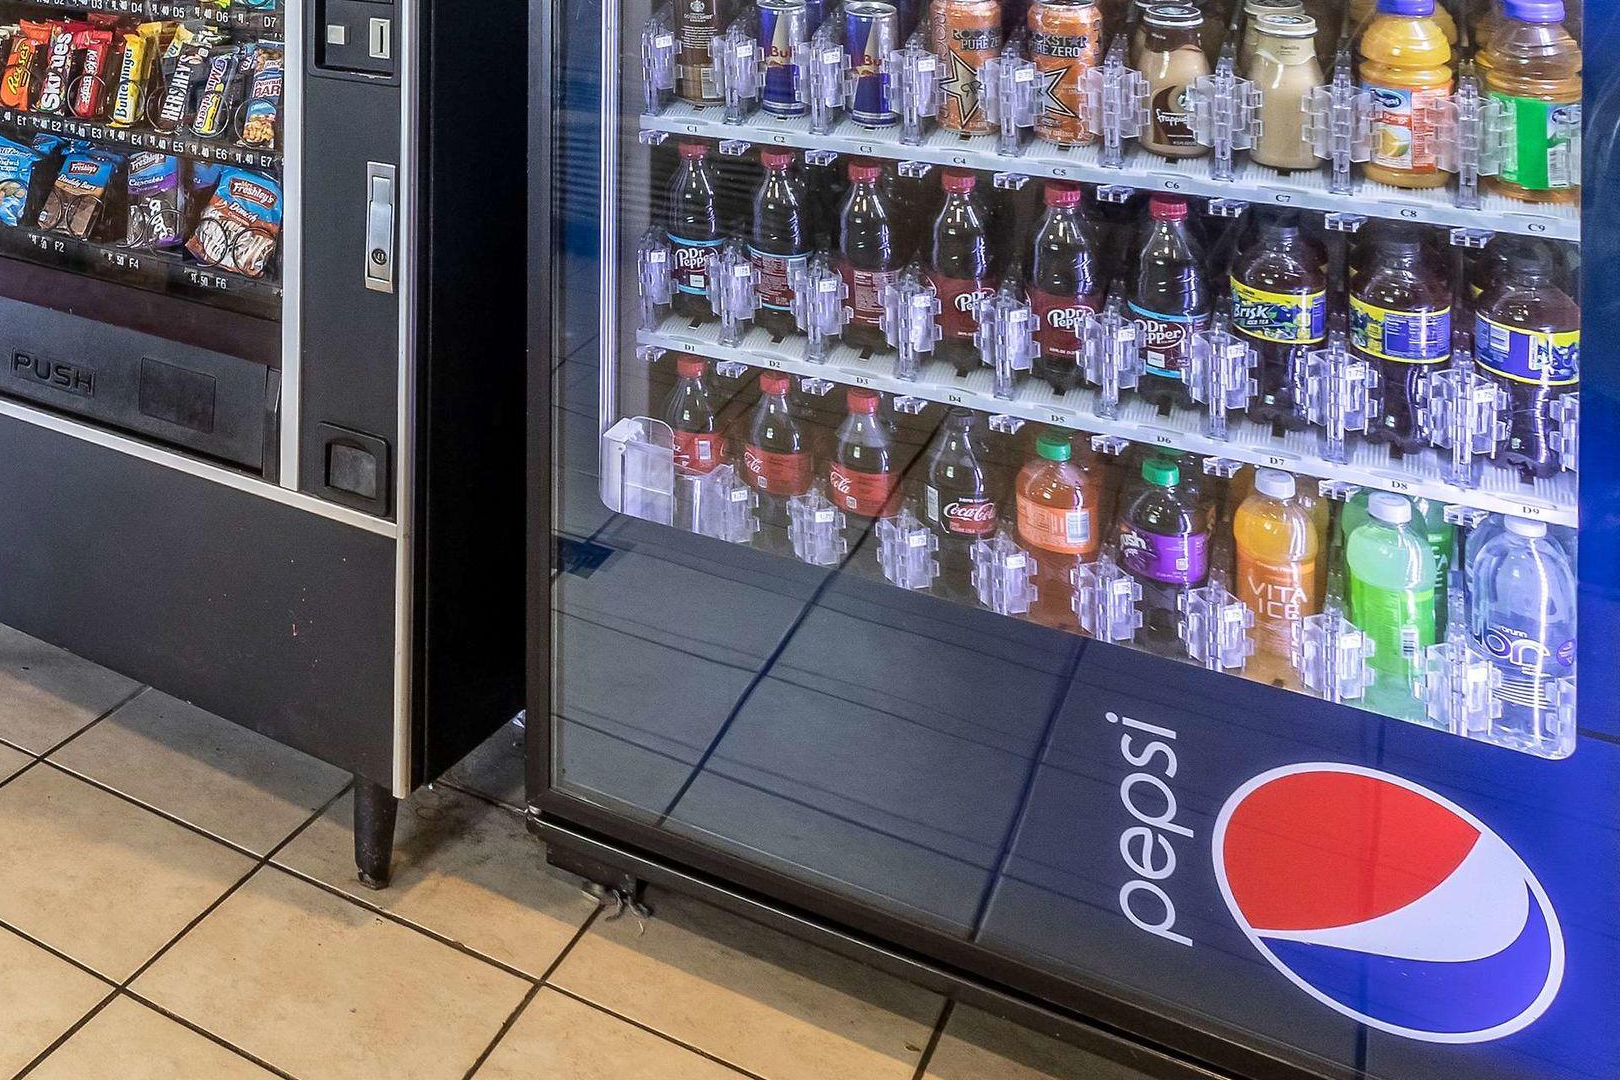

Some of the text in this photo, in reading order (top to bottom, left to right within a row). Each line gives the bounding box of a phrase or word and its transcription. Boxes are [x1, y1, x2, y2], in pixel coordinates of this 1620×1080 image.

[1051, 44, 1080, 58] ZERO
[253, 87, 281, 98] BAR
[91, 127, 102, 139] E3
[131, 135, 142, 146] E4
[172, 141, 184, 152] E5
[215, 148, 228, 160] E6
[260, 156, 273, 168] E7
[1165, 181, 1179, 190] C6
[1276, 195, 1290, 203] C7
[1401, 209, 1417, 218] C8
[1528, 224, 1545, 232] C9
[54, 241, 65, 253] F2
[129, 258, 139, 269] F4
[215, 277, 227, 289] F6
[1147, 319, 1167, 334] Dr
[685, 344, 694, 352] D1
[770, 360, 780, 369] D2
[14, 351, 93, 394] PUSH
[856, 377, 869, 385] D3
[949, 395, 960, 403] D4
[1157, 436, 1171, 444] D6
[1269, 457, 1285, 465] D7
[1392, 481, 1407, 490] D8
[1522, 506, 1540, 515] D9
[1248, 576, 1308, 604] VITA
[1105, 711, 1194, 946] pepsi
